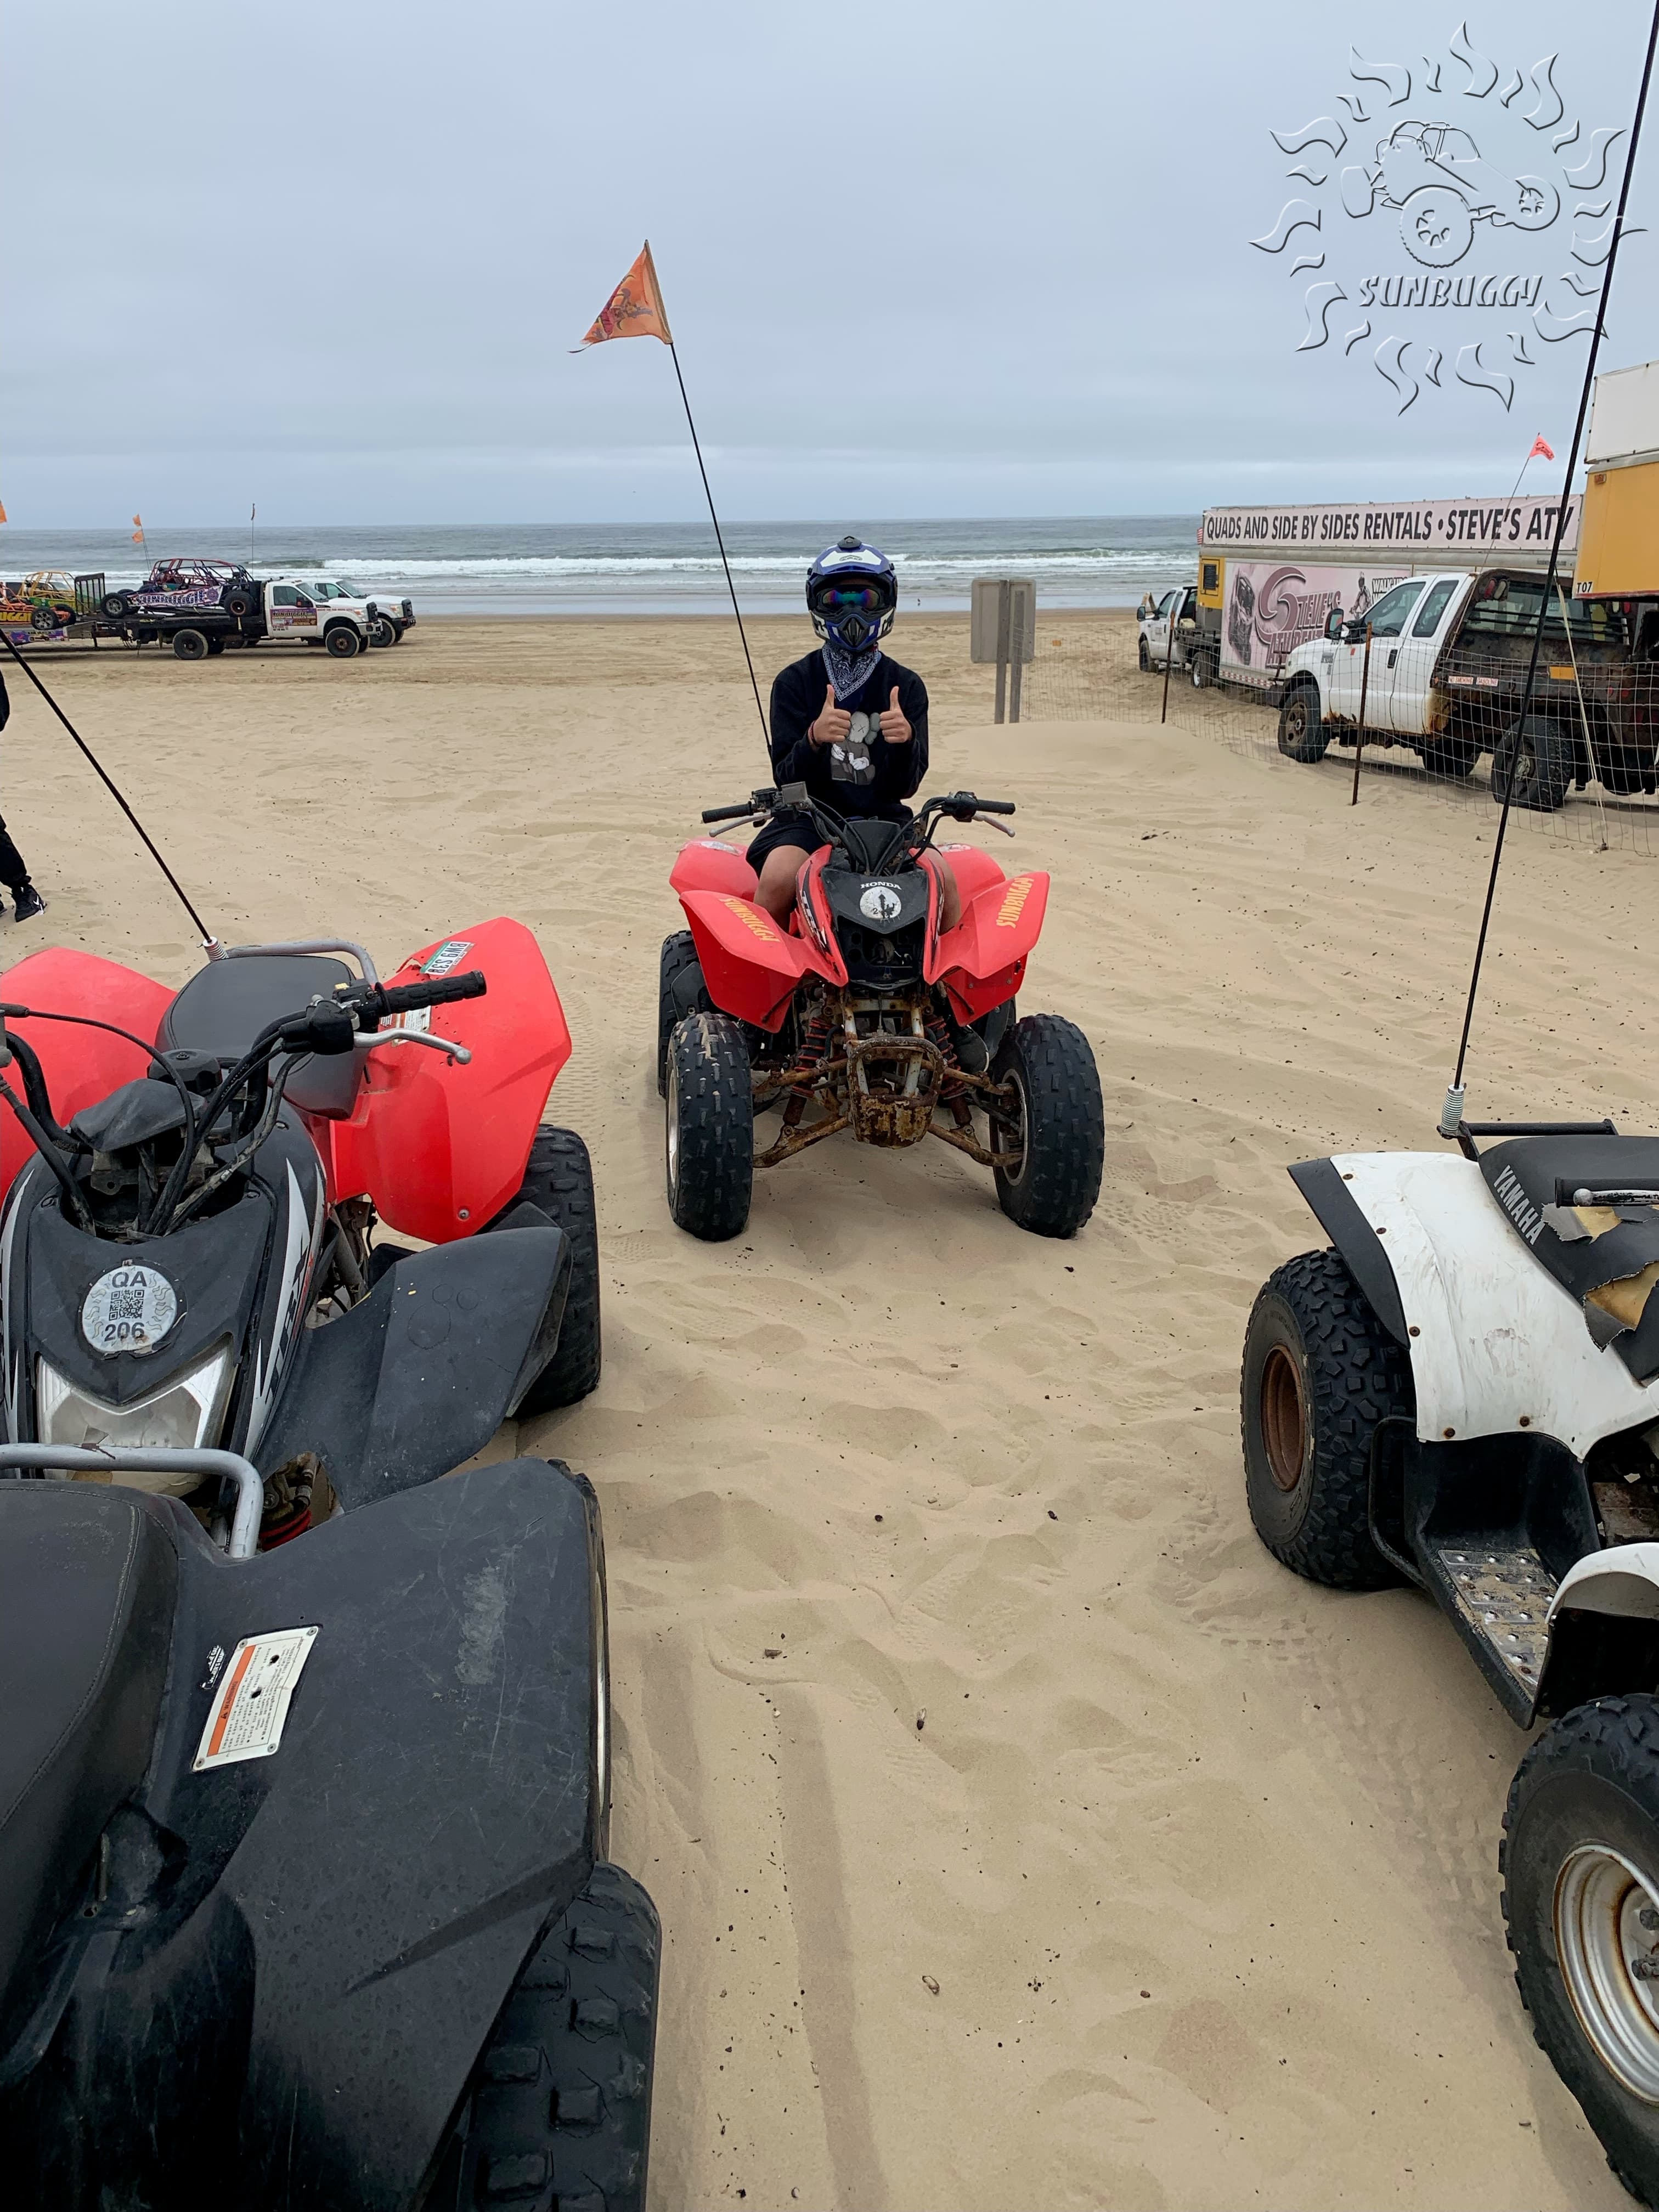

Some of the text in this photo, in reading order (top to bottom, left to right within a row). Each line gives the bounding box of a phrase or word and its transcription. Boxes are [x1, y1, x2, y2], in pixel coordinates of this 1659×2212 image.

[1207, 506, 1575, 540] QUADS AND SIDE BY SIDES RENTALS STEVE'S ATV
[860, 881, 902, 890] HONDA
[996, 877, 1034, 929] SUNBUGGY
[718, 898, 781, 942] SUNBUGGY
[1493, 1164, 1545, 1245] YAMAHA
[111, 1271, 148, 1288] QA
[104, 1322, 145, 1342] 206
[222, 1680, 239, 1711] WARNING
